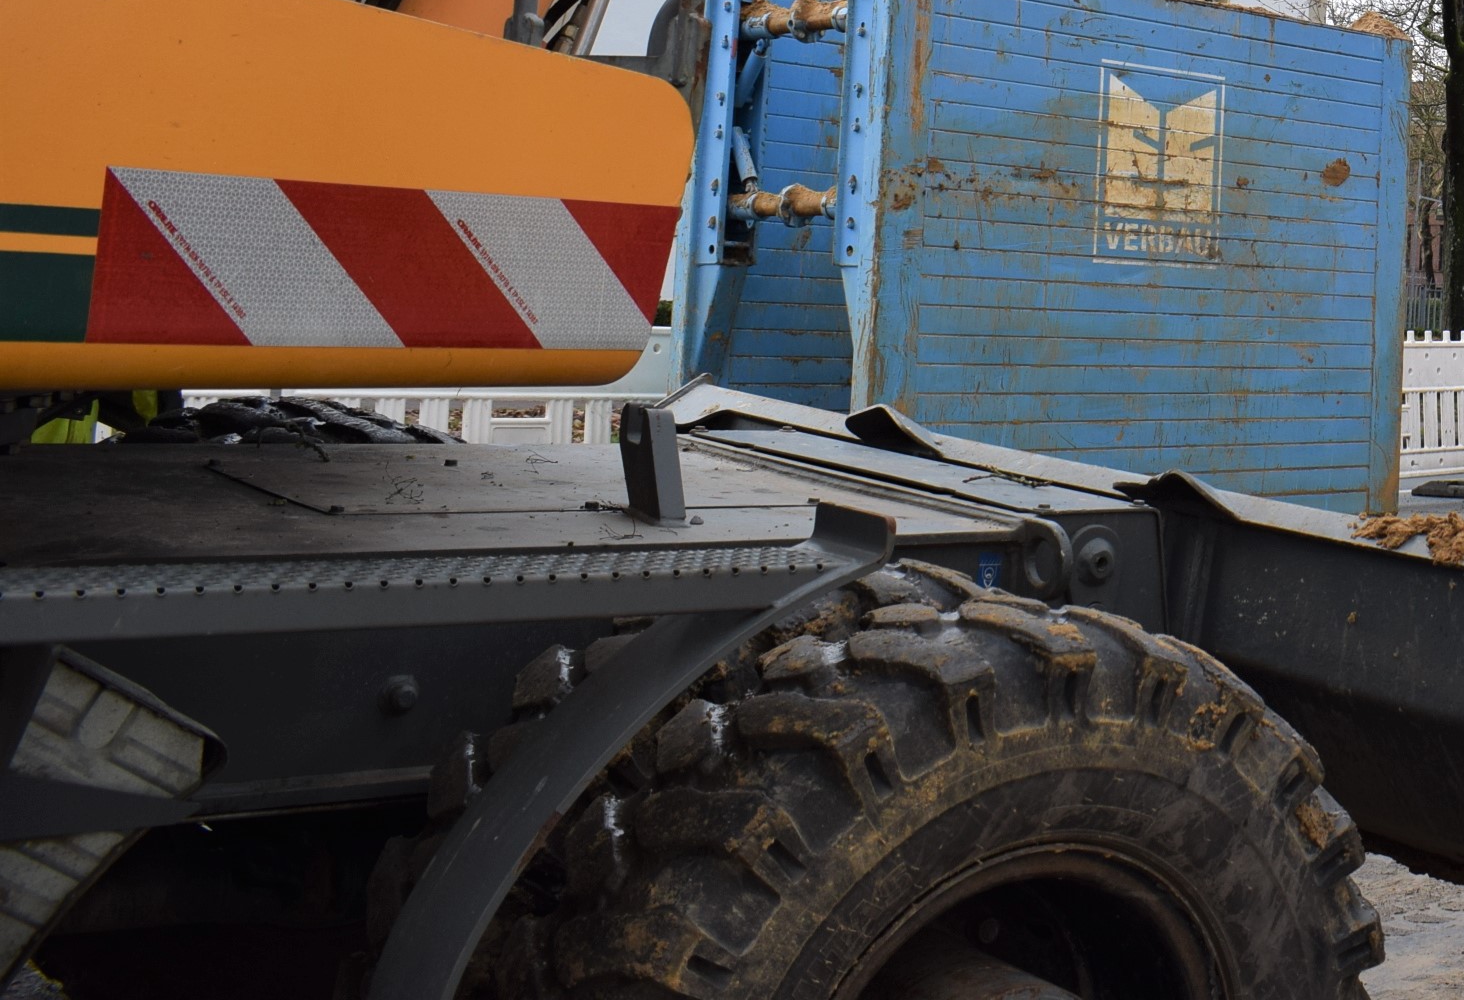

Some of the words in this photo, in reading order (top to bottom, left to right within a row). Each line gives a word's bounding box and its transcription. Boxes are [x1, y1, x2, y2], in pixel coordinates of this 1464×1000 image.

[147, 200, 178, 236] ORALITE
[457, 219, 482, 250] ORALITE
[1104, 221, 1213, 258] VERBAU
